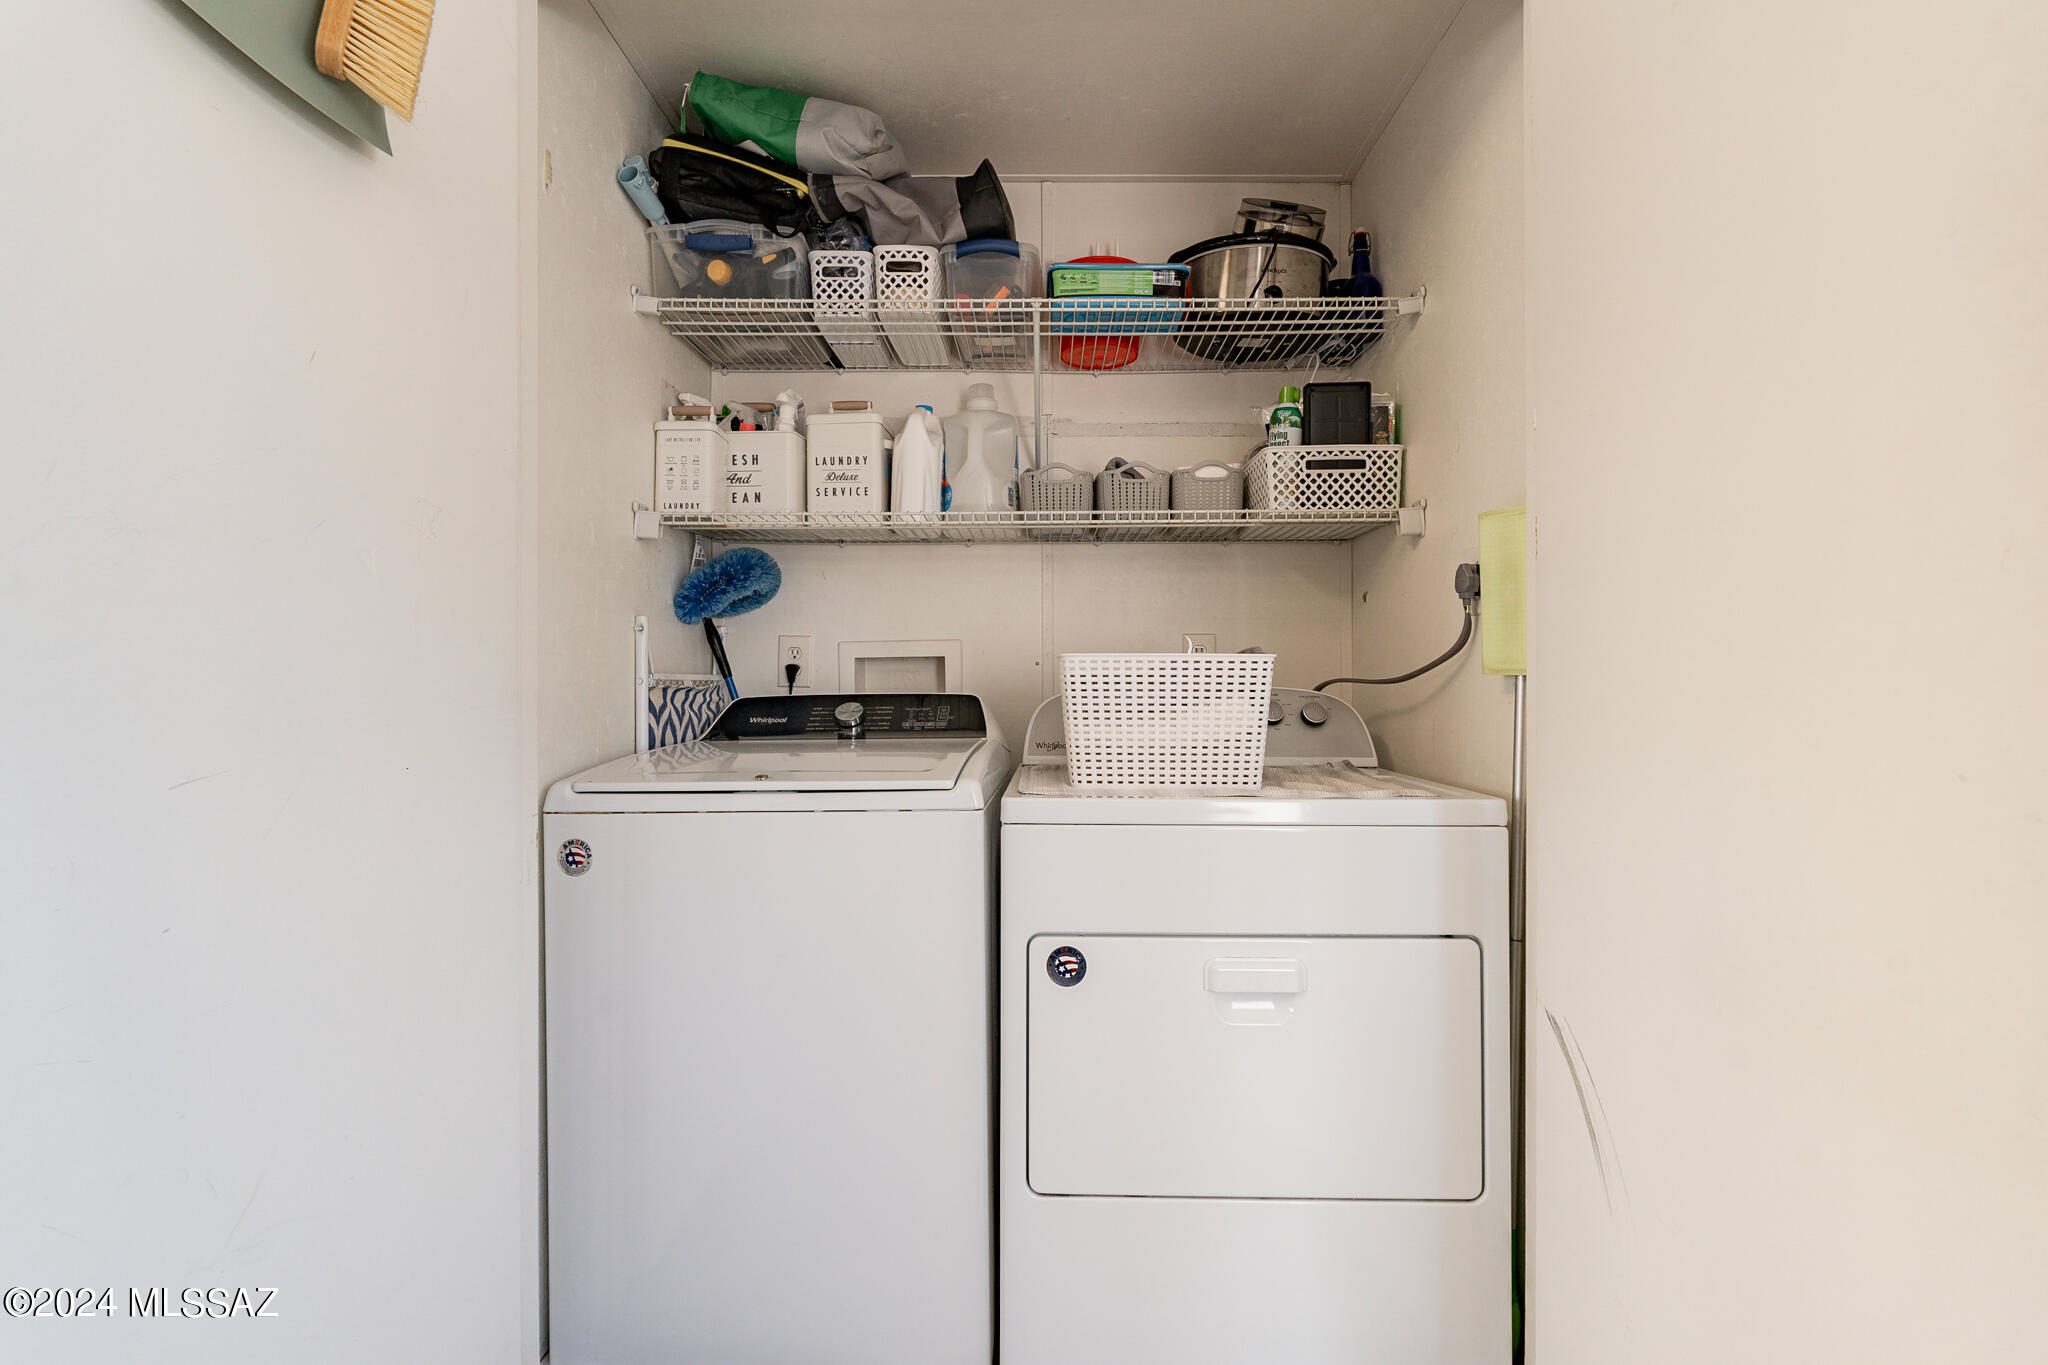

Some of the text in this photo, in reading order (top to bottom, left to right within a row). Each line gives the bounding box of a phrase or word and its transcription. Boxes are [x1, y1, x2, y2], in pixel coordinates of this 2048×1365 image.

[731, 454, 759, 466] ESH
[815, 455, 868, 466] LAUNDRY
[726, 473, 752, 484] And
[824, 471, 860, 481] Deluxe
[815, 486, 869, 497] SERVICE
[731, 492, 761, 503] EAN
[663, 502, 701, 510] LAUNDRY
[749, 716, 788, 725] Whirlpool
[1035, 741, 1066, 752] Whirlpoo
[562, 839, 592, 859] AMERICA
